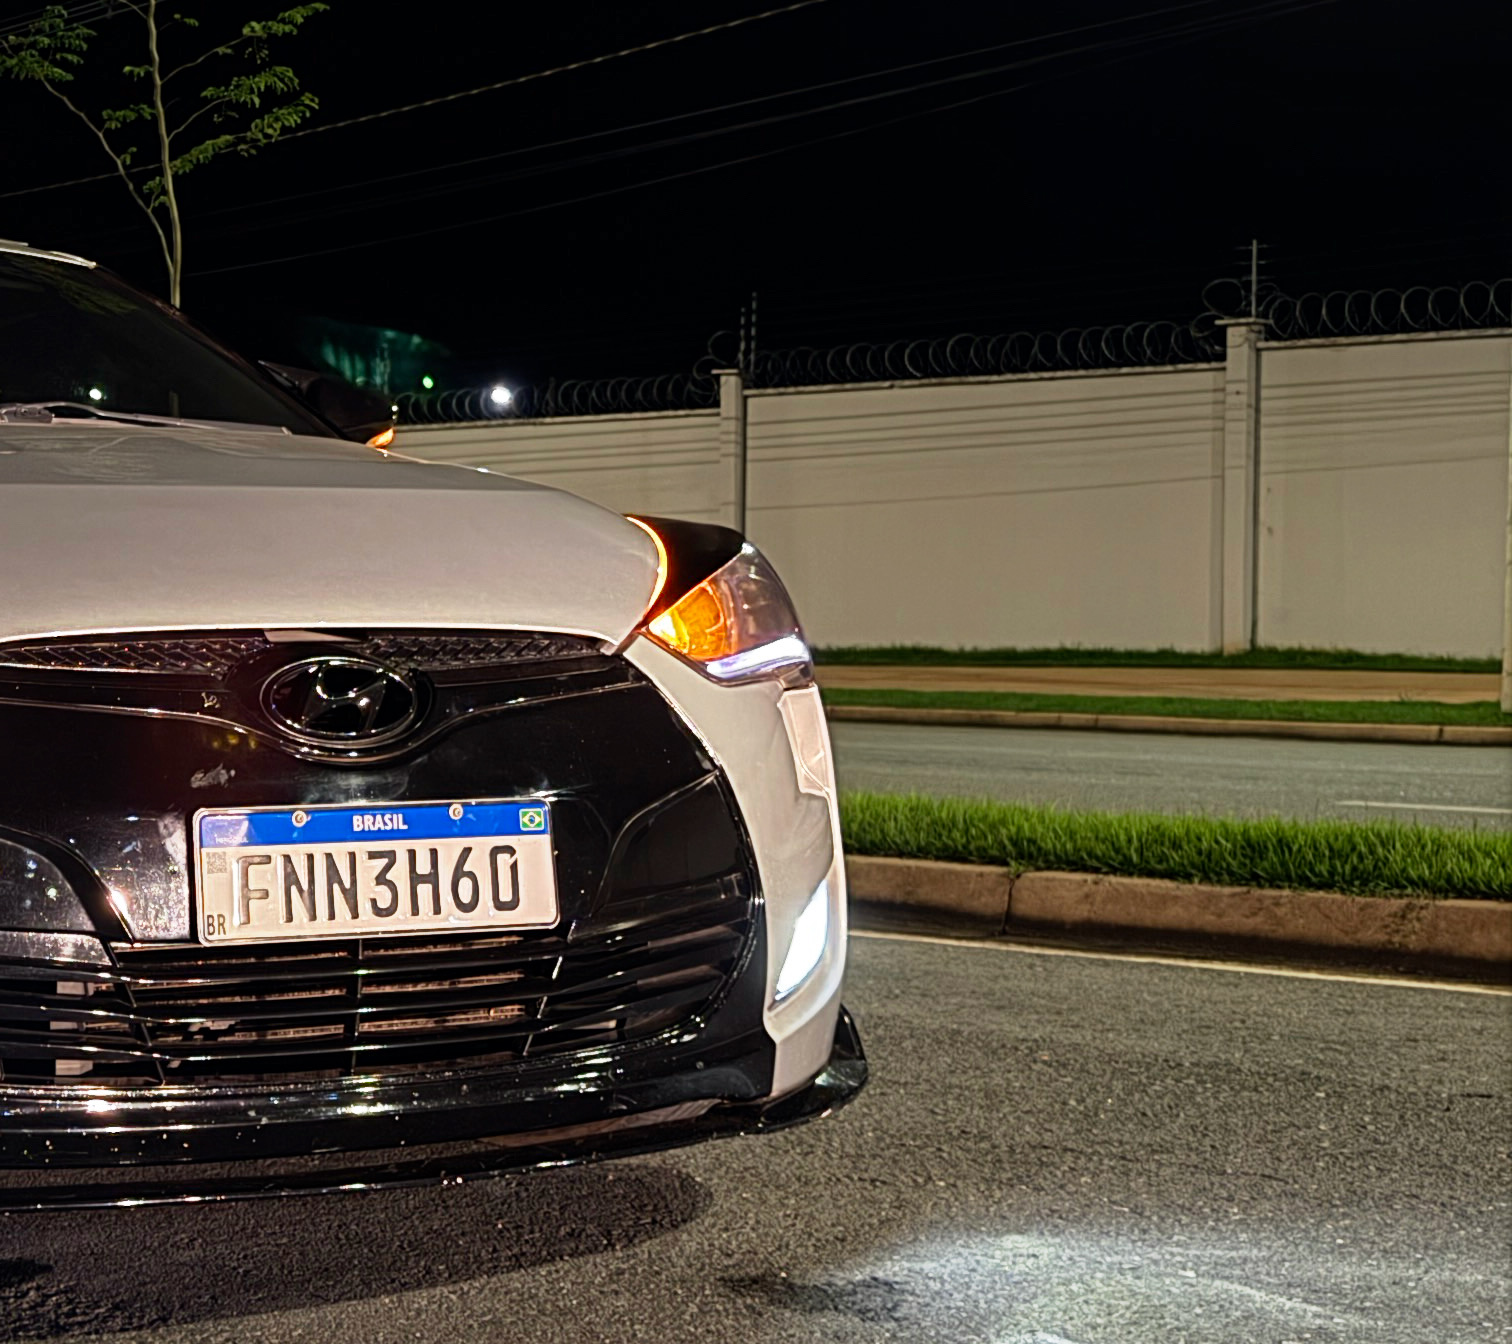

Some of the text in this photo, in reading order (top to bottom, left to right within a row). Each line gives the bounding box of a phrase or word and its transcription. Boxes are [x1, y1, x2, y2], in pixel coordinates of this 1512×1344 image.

[352, 813, 408, 832] BRASIL
[236, 845, 520, 925] FNN3H60
[206, 914, 227, 936] BR
